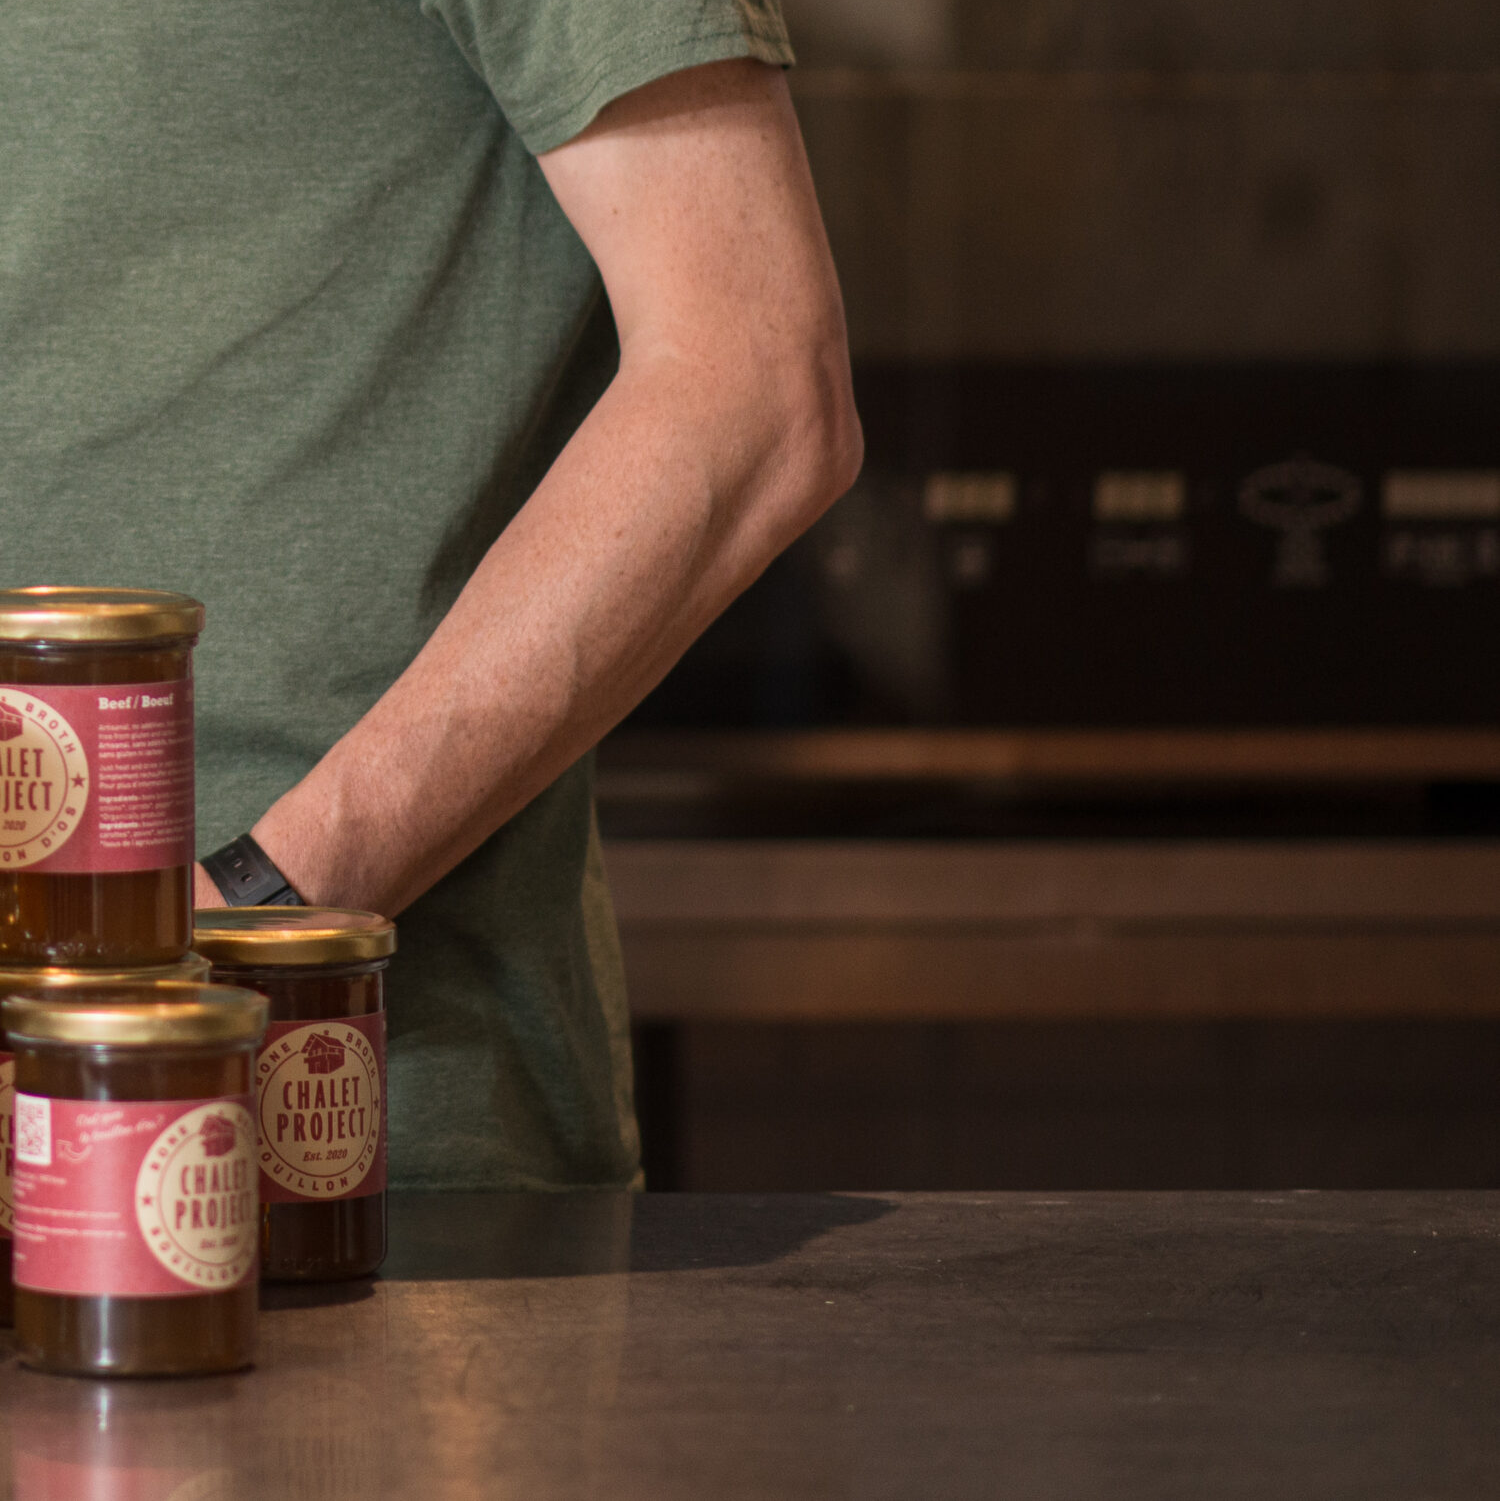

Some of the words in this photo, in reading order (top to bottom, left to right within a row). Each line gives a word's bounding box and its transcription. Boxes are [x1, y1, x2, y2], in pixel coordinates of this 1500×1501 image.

[98, 696, 132, 710] Beef
[141, 693, 174, 708] Boeuf
[25, 701, 76, 754] BROTH
[41, 806, 77, 849] D'OS
[346, 1032, 376, 1078] BROTH
[283, 1076, 360, 1109] CHALET
[277, 1107, 365, 1144] PROJECT
[303, 1151, 322, 1162] Est.
[326, 1148, 347, 1160] 2020
